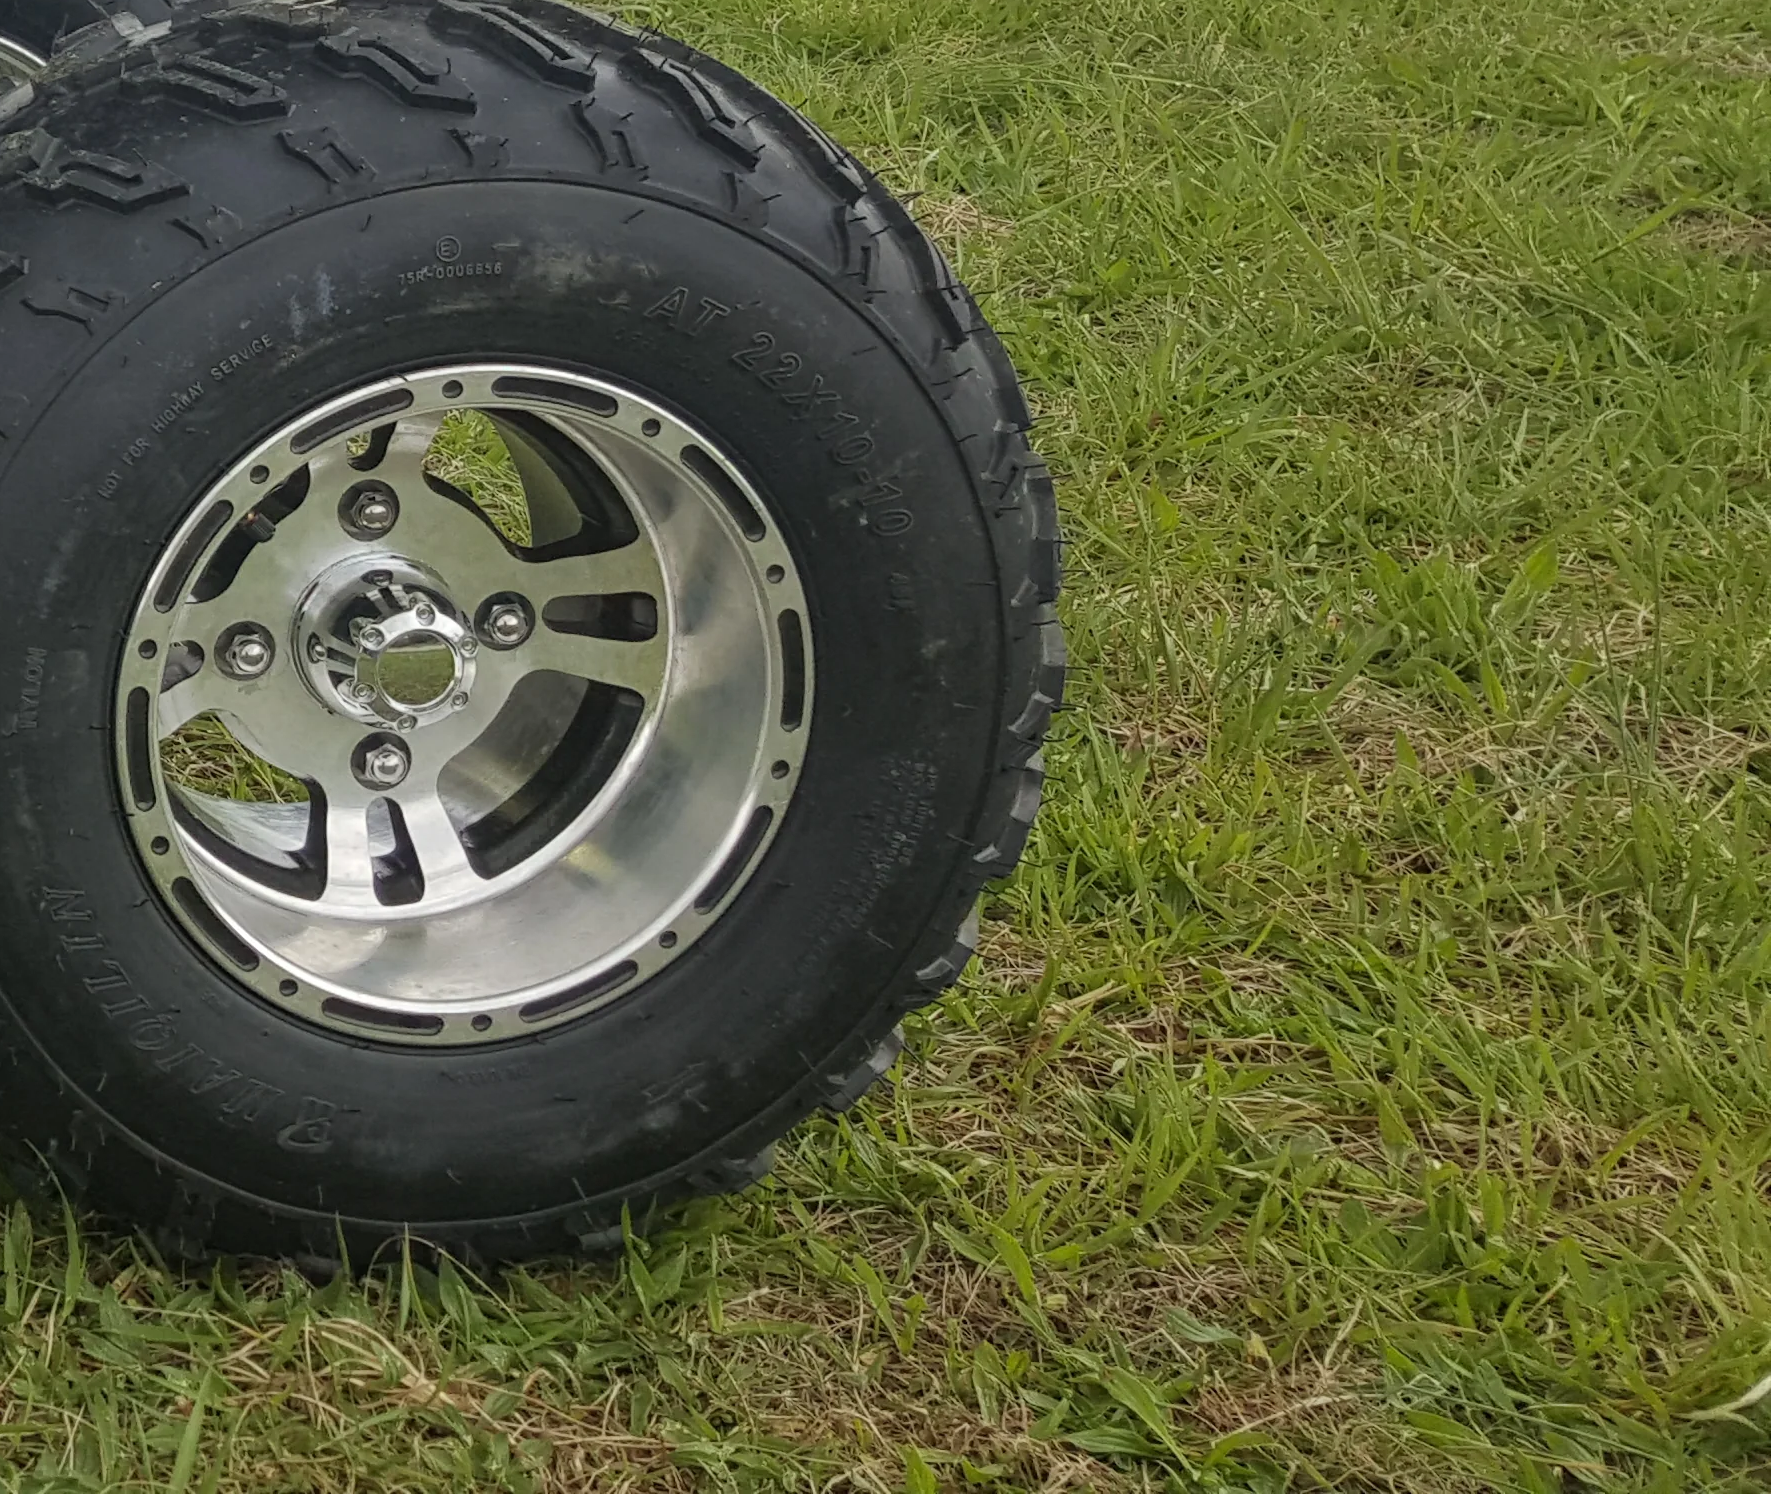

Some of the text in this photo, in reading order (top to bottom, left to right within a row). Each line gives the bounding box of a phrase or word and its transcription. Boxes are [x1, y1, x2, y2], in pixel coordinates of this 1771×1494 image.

[97, 334, 273, 500] NOT FOR HIGHWAY SERVICE
[643, 285, 731, 337] AT
[731, 331, 916, 537] 22X10-10
